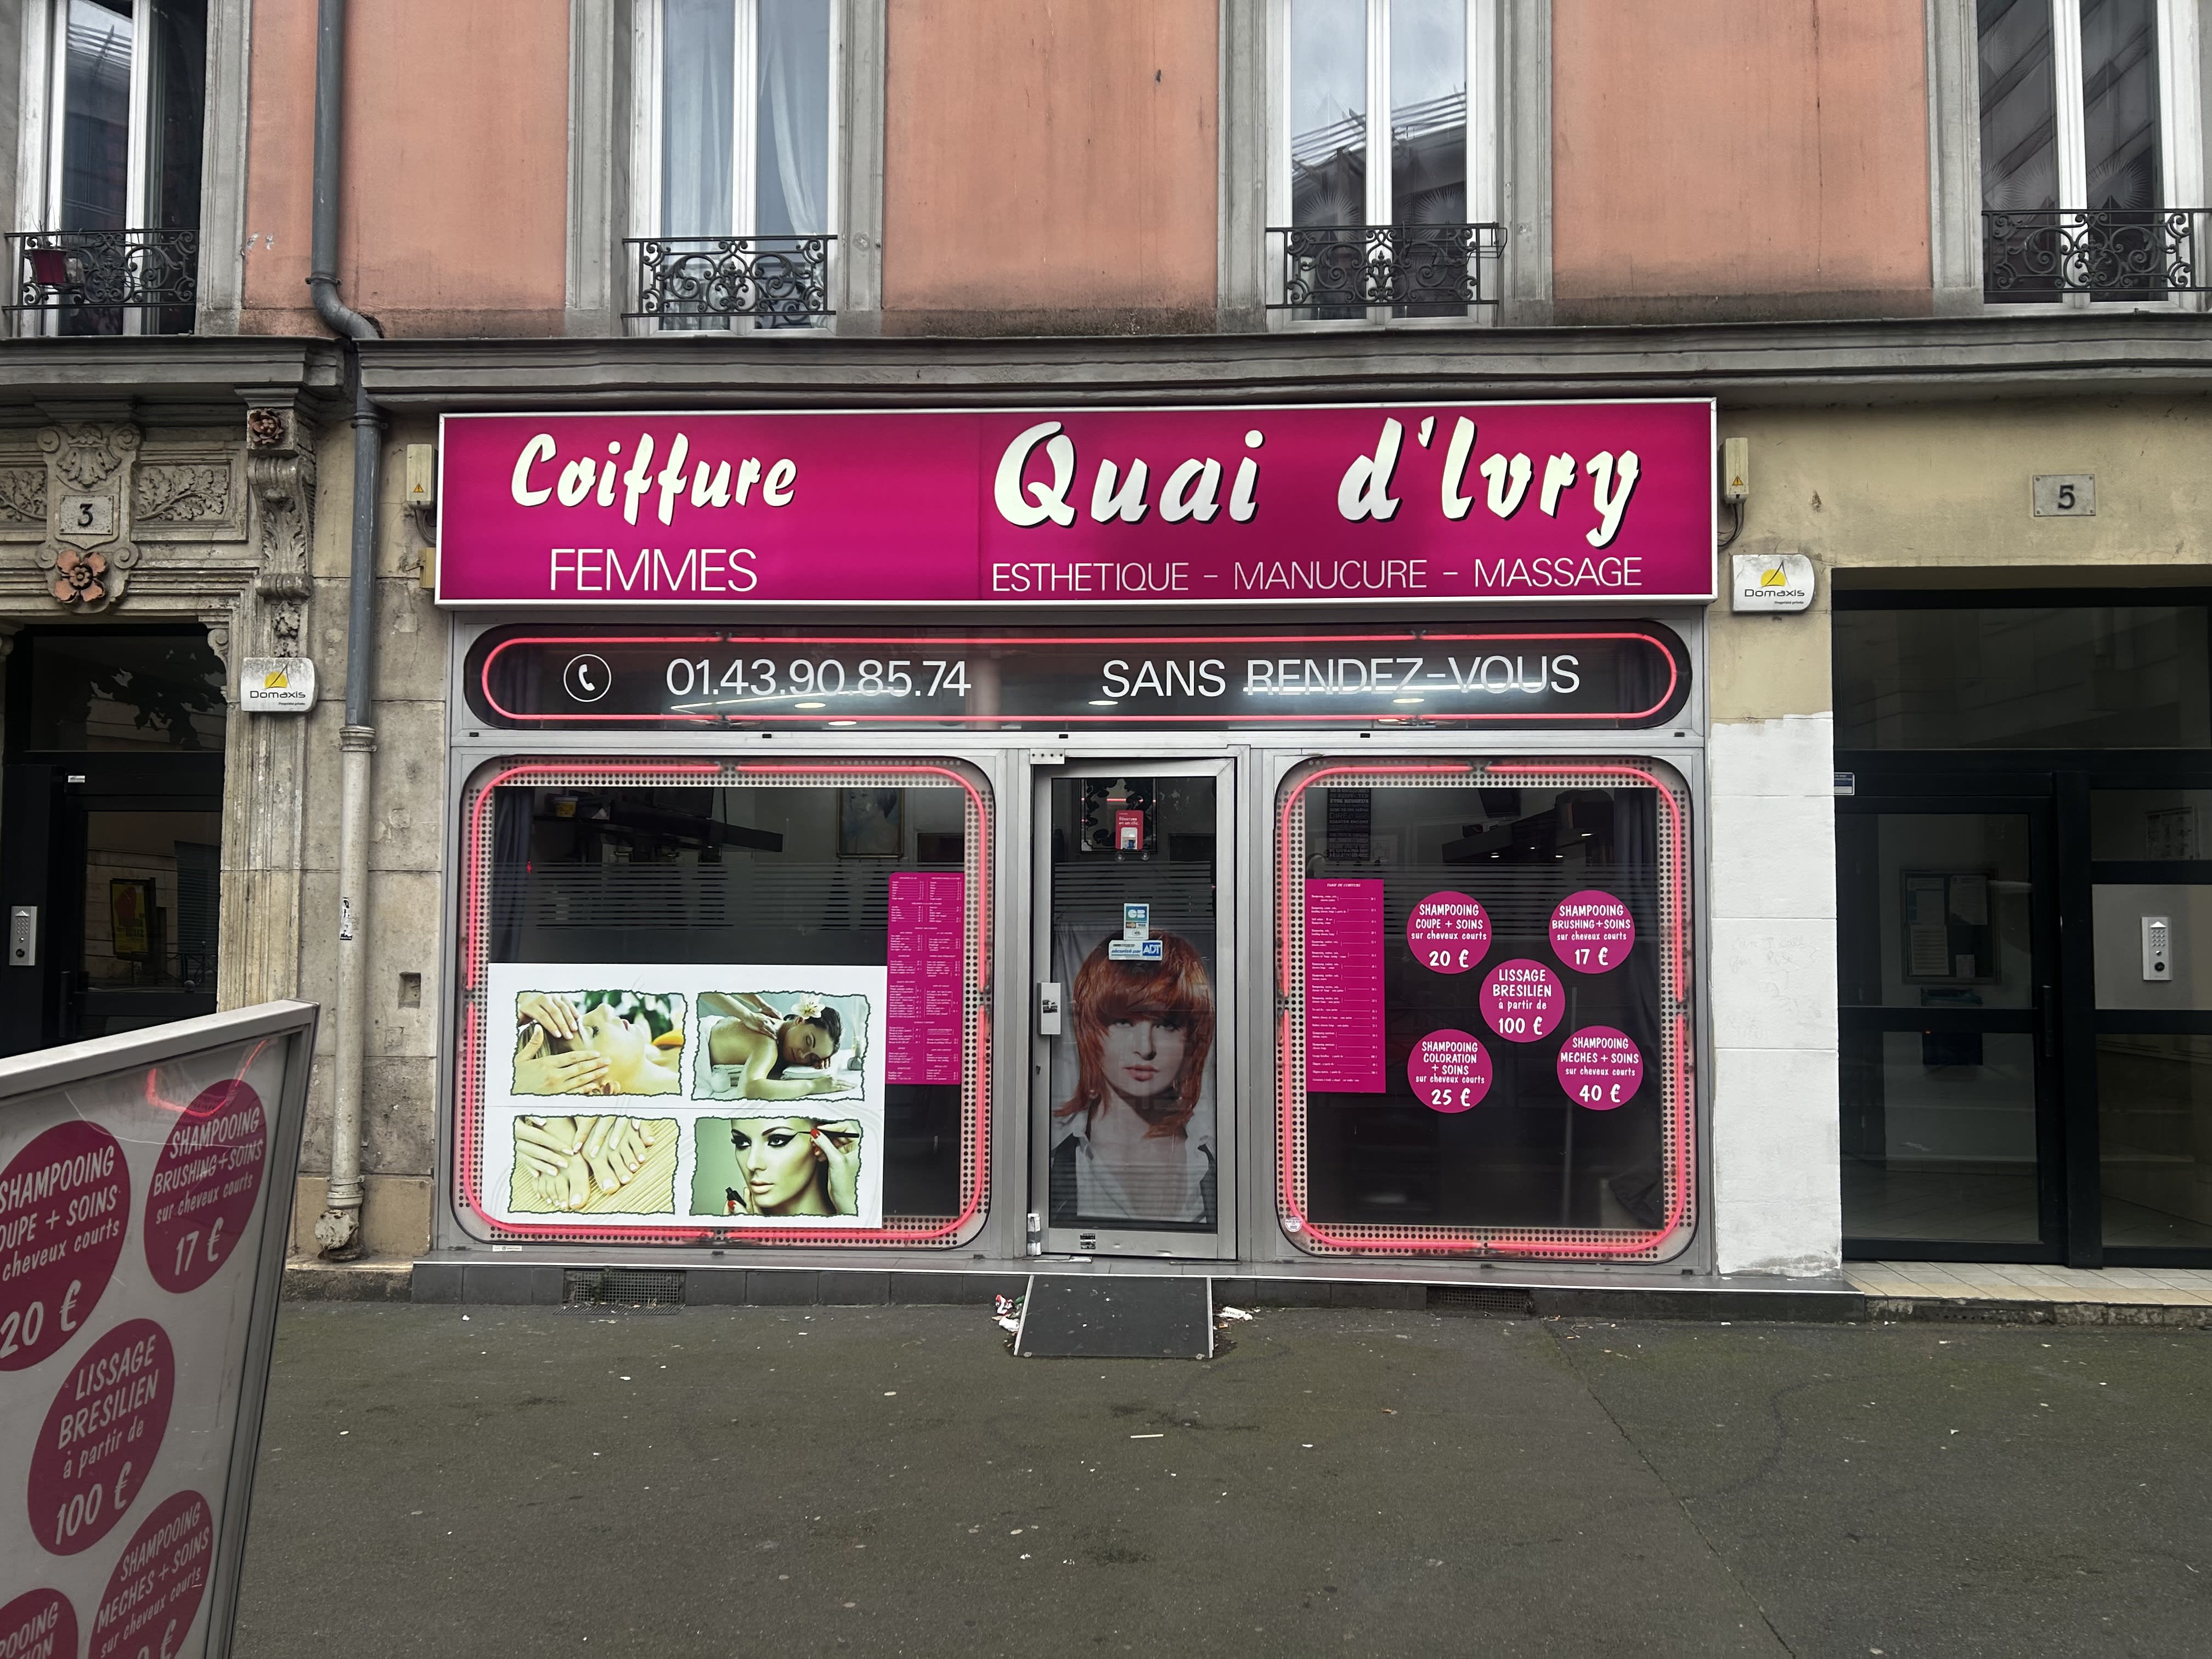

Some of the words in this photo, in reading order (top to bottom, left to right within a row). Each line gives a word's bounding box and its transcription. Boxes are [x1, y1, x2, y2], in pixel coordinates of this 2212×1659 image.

[512, 433, 795, 525] Coiffure
[995, 421, 1262, 526] Quai
[1338, 416, 1639, 546] d'Ivry
[2058, 485, 2075, 509] 5
[78, 504, 93, 528] 3
[551, 549, 757, 591] FEMMES
[994, 563, 1188, 591] ESTHETIQUE
[1235, 560, 1427, 589] MANUCURE
[1476, 557, 1641, 586] MASSAGE
[666, 658, 971, 697] 01.43.90.85.74
[1102, 659, 1226, 697] SANS
[1246, 655, 1580, 695] RENDEZ-VOUS
[1128, 909, 1146, 918] CB
[1419, 904, 1479, 916] SHAMPOOING
[1560, 905, 1623, 917] SHAMPOOING
[1416, 919, 1440, 928] COUPE
[1456, 919, 1483, 929] SOINS
[1427, 931, 1458, 939] cheveux
[1462, 932, 1486, 940] courts
[1572, 931, 1600, 940] cheveux
[1143, 944, 1160, 954] ADT
[1429, 951, 1450, 966] 20
[1459, 950, 1469, 967] €
[1575, 949, 1590, 964] 17
[1599, 947, 1608, 965] €
[1499, 969, 1545, 981] LISSAGE
[1493, 984, 1551, 997] BRESILIEN
[1508, 1000, 1532, 1012] partir
[1537, 1000, 1547, 1009] de
[1499, 1018, 1525, 1033] 100
[1533, 1017, 1542, 1035] €
[1422, 1041, 1477, 1052] SHAMPOOING
[1572, 1037, 1628, 1049] SHAMPOOING
[1424, 1053, 1476, 1063] COLORATION
[1561, 1052, 1598, 1063] MECHES
[1611, 1053, 1639, 1063] SOINS
[1430, 1075, 1459, 1083] cheveux
[1462, 1075, 1484, 1084] courts
[1442, 1065, 1469, 1075] SOINS
[1580, 1066, 1609, 1075] cheveux
[1431, 1090, 1452, 1105] 25
[1460, 1088, 1470, 1106] €
[1579, 1085, 1601, 1102] 40
[1610, 1084, 1620, 1102] €
[170, 1107, 260, 1159] SHAMPOOING
[0, 1145, 115, 1214] SHAMPOOING
[156, 1203, 174, 1224] sur
[178, 1186, 219, 1216] cheveux
[223, 1171, 253, 1198] courts
[0, 1212, 37, 1253] OUPE
[66, 1184, 117, 1227] SOINS
[2, 1239, 67, 1281] cheveux
[74, 1218, 120, 1252] courts
[174, 1231, 199, 1276] 17
[207, 1217, 224, 1262] €
[0, 1301, 44, 1359] 20
[59, 1280, 81, 1331] €
[76, 1334, 156, 1401] LISSAGE
[58, 1369, 159, 1449] BRESILIEN
[78, 1427, 123, 1478] partir
[128, 1415, 144, 1442] de
[56, 1483, 102, 1545] 100
[114, 1462, 132, 1510] €
[121, 1502, 201, 1581] SHAMPOOING
[97, 1570, 155, 1633] MECHES
[172, 1527, 210, 1573] SOINS
[101, 1633, 119, 1658] sur
[123, 1594, 166, 1640] cheveux
[171, 1567, 201, 1602] courts
